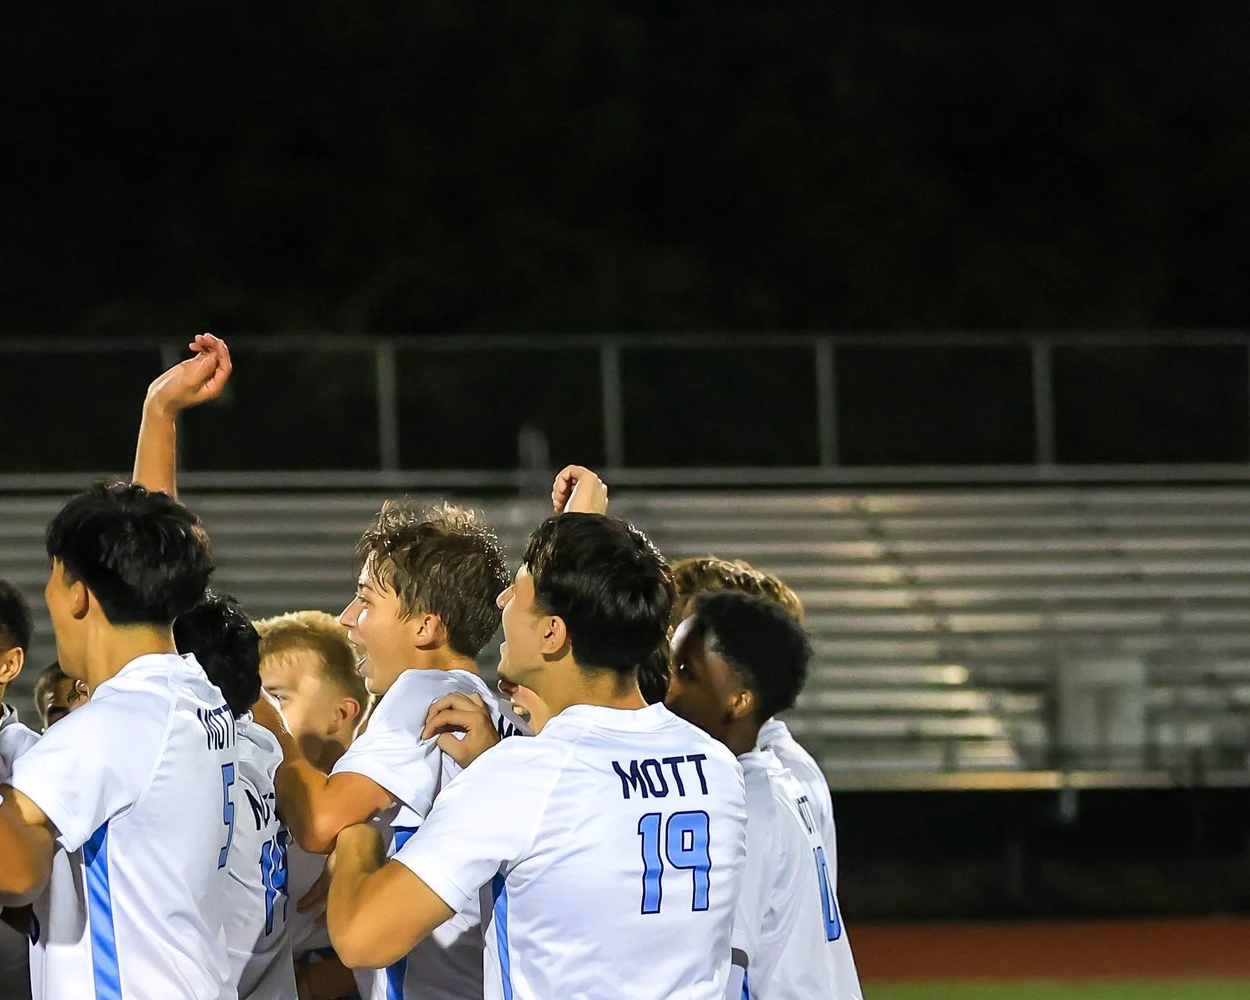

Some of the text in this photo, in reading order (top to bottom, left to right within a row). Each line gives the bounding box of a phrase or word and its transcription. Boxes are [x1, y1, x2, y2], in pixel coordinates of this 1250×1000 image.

[197, 703, 236, 751] MOTT
[611, 753, 708, 799] MOTT
[637, 809, 712, 915] 19
